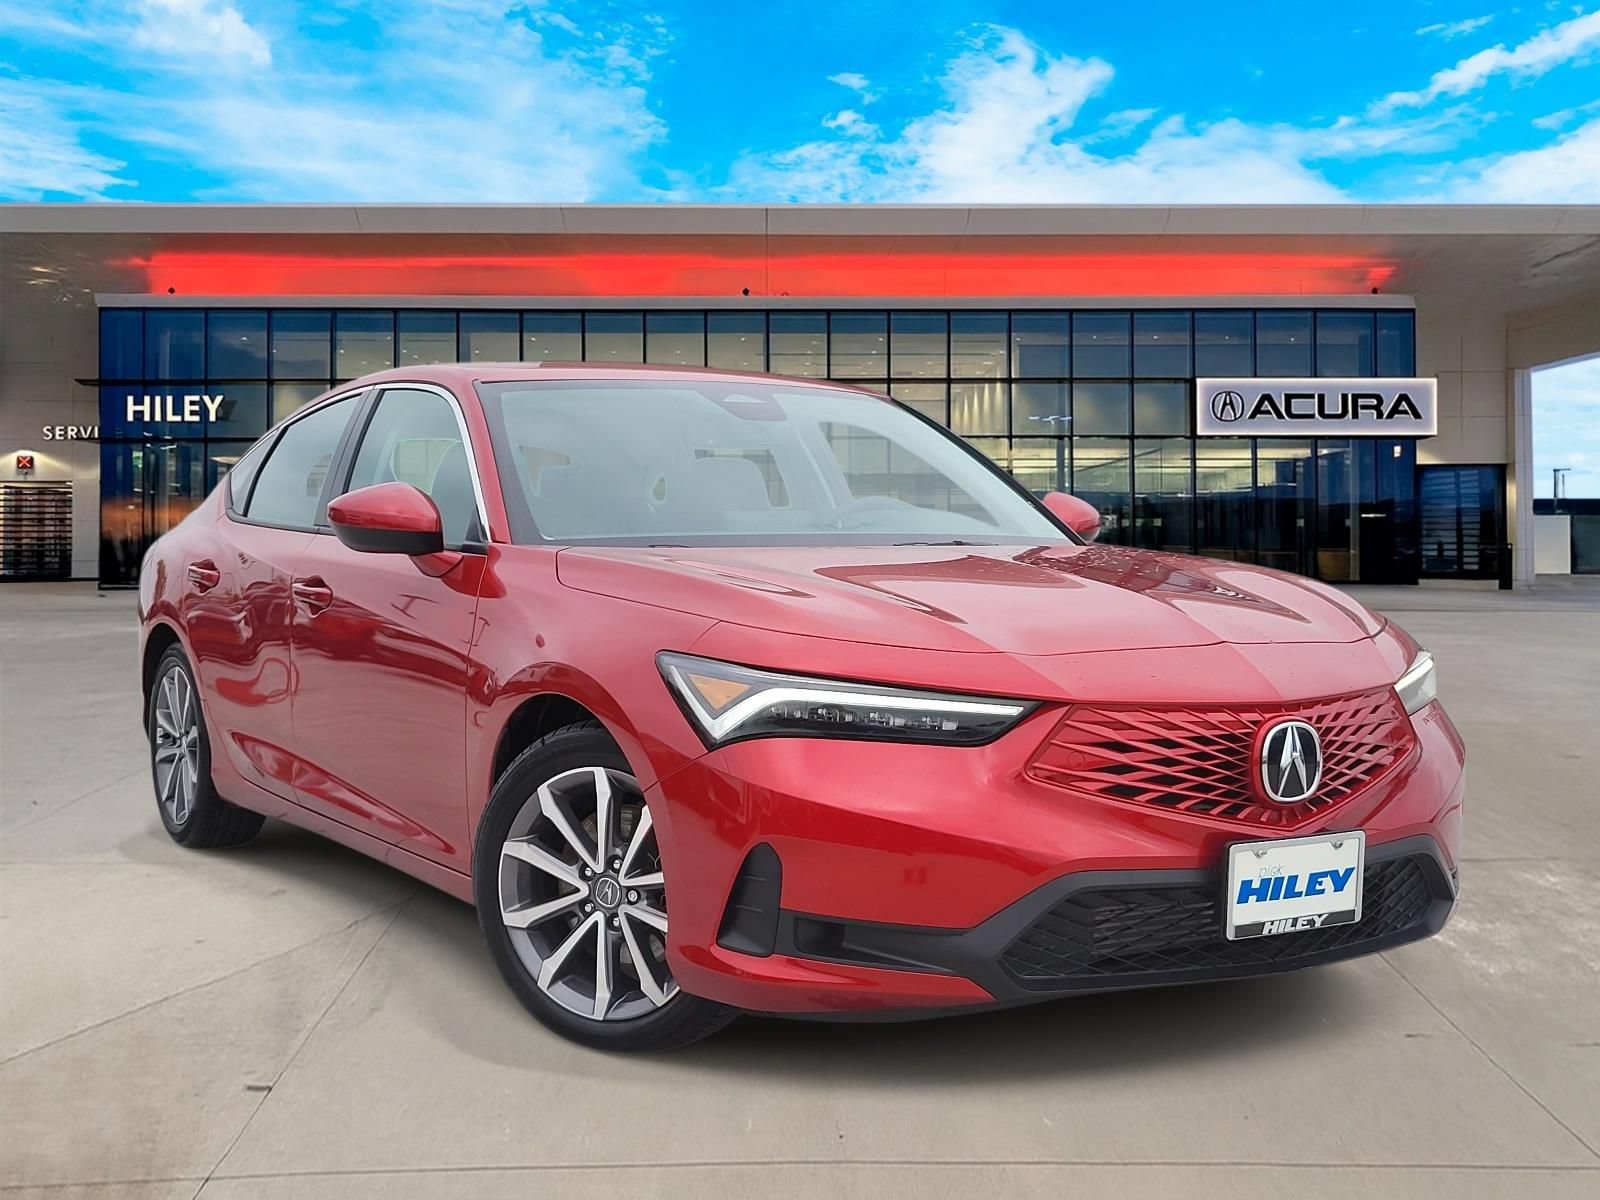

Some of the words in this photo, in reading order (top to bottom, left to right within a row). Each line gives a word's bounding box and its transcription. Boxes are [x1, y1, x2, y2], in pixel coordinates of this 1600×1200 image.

[126, 395, 224, 422] HILEY
[1248, 393, 1422, 420] ACURA
[42, 425, 99, 440] SERVI
[1236, 867, 1355, 905] HILEY
[1262, 914, 1328, 935] HILEY
